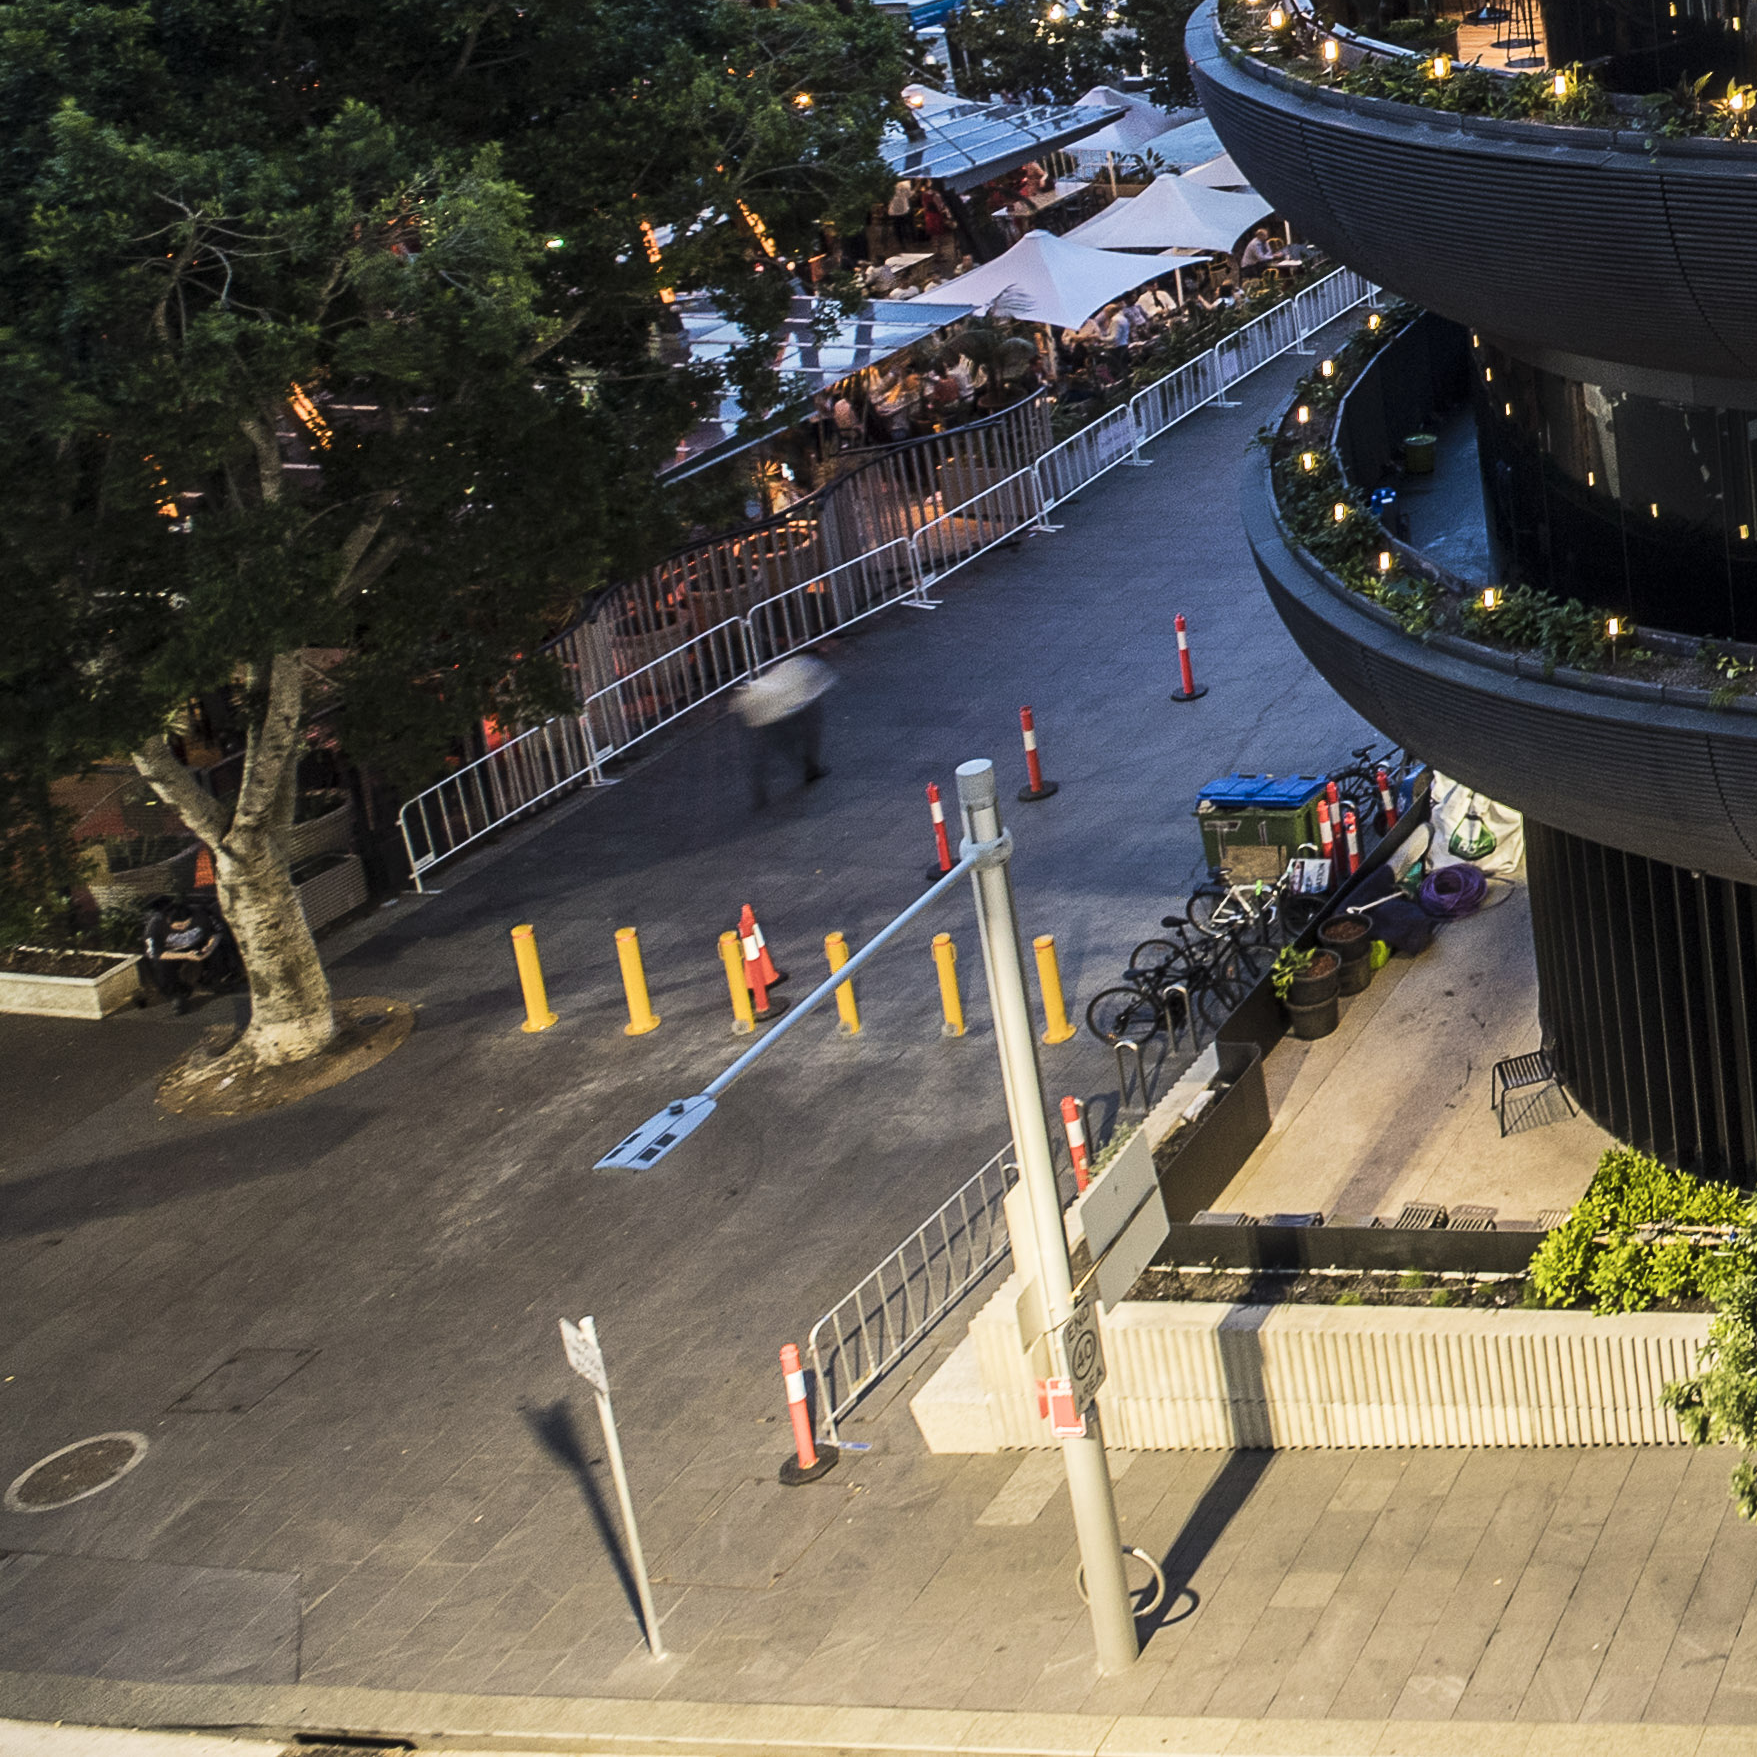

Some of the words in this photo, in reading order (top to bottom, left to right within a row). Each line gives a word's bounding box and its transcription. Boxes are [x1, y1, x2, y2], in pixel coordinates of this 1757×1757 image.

[1066, 1303, 1090, 1344] END
[1076, 1337, 1093, 1371] 40
[1078, 1366, 1103, 1406] AREA
